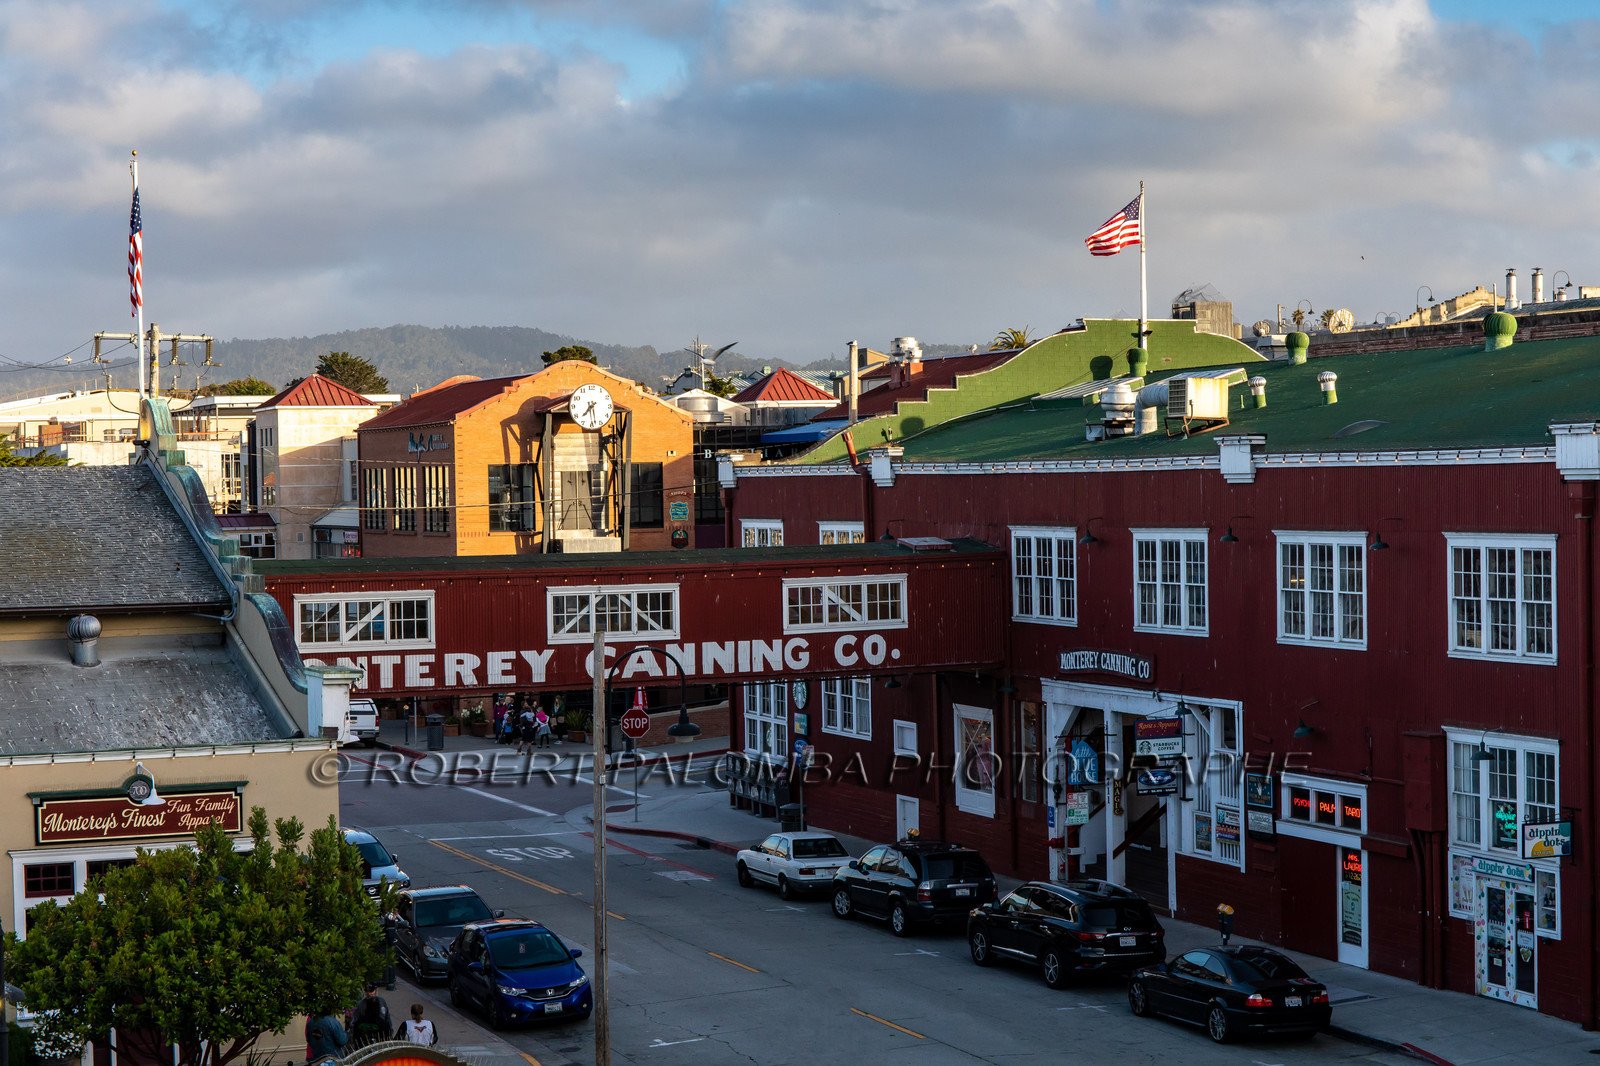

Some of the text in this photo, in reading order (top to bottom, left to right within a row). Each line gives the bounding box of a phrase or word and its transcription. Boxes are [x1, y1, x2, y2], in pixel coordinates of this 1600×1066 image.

[585, 637, 810, 679] CANNING
[834, 634, 900, 667] CO.
[1060, 651, 1150, 679] MONTEREY CANNING CO
[623, 718, 647, 729] STOP
[1071, 758, 1096, 772] BLUE
[1070, 772, 1096, 783] HOUSE
[132, 786, 148, 796] 700
[1114, 780, 1122, 814] MAGIC
[167, 798, 235, 814] Fun Family
[43, 808, 166, 836] Monterey's Finest
[178, 812, 226, 830] Appael
[1544, 838, 1566, 847] dots
[486, 846, 575, 862] STOP
[1478, 860, 1504, 873] dippin'
